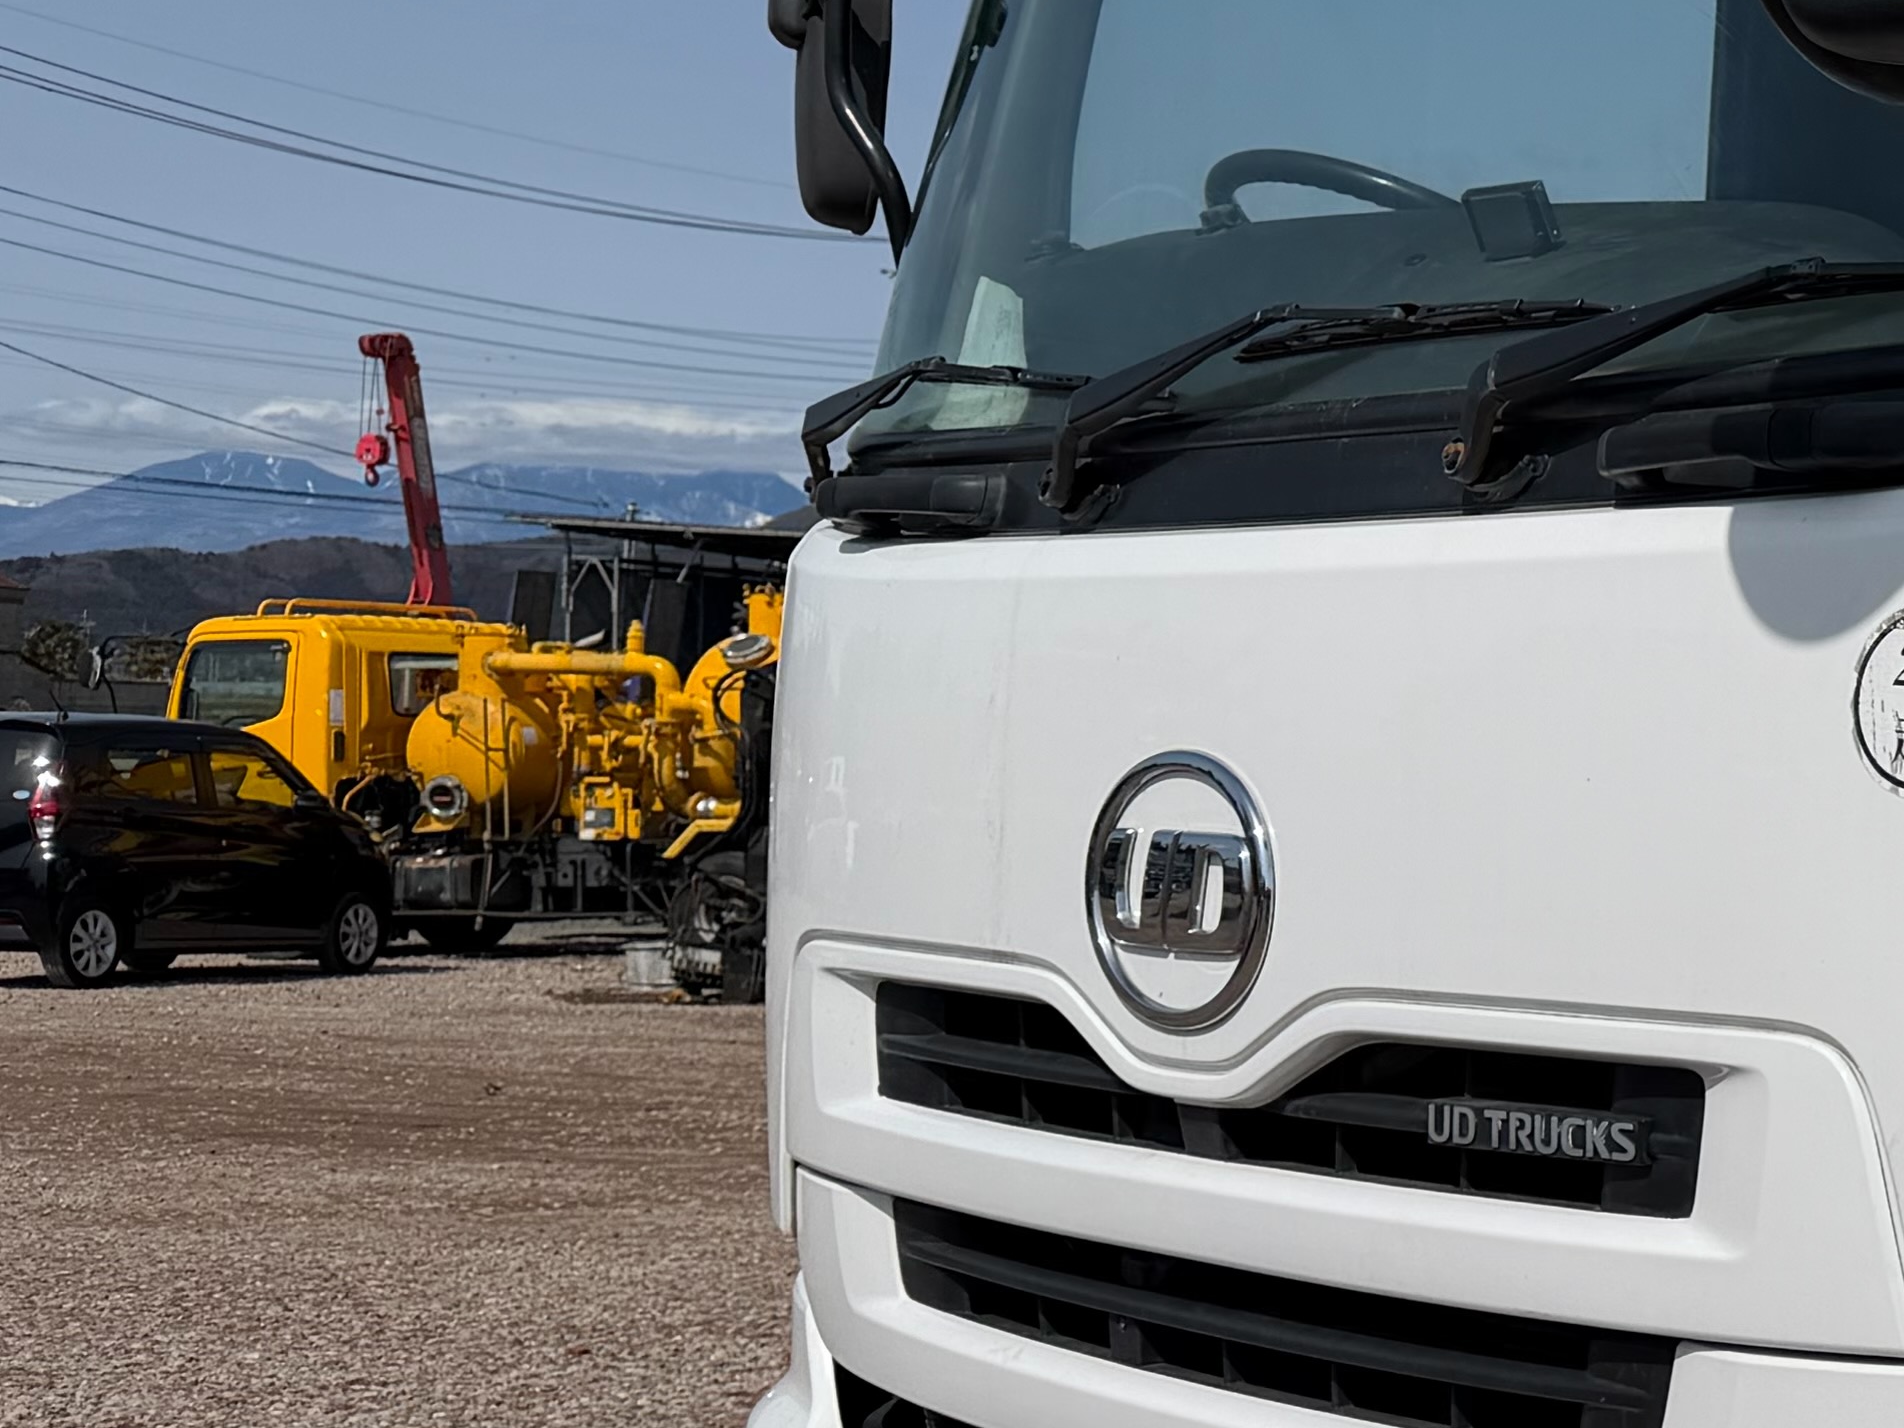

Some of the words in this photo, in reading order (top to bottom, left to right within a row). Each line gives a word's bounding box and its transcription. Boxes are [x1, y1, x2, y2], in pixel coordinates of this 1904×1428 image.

[1102, 827, 1250, 961] UD
[1427, 1103, 1476, 1145] UD
[1483, 1109, 1637, 1161] TRUCKS
